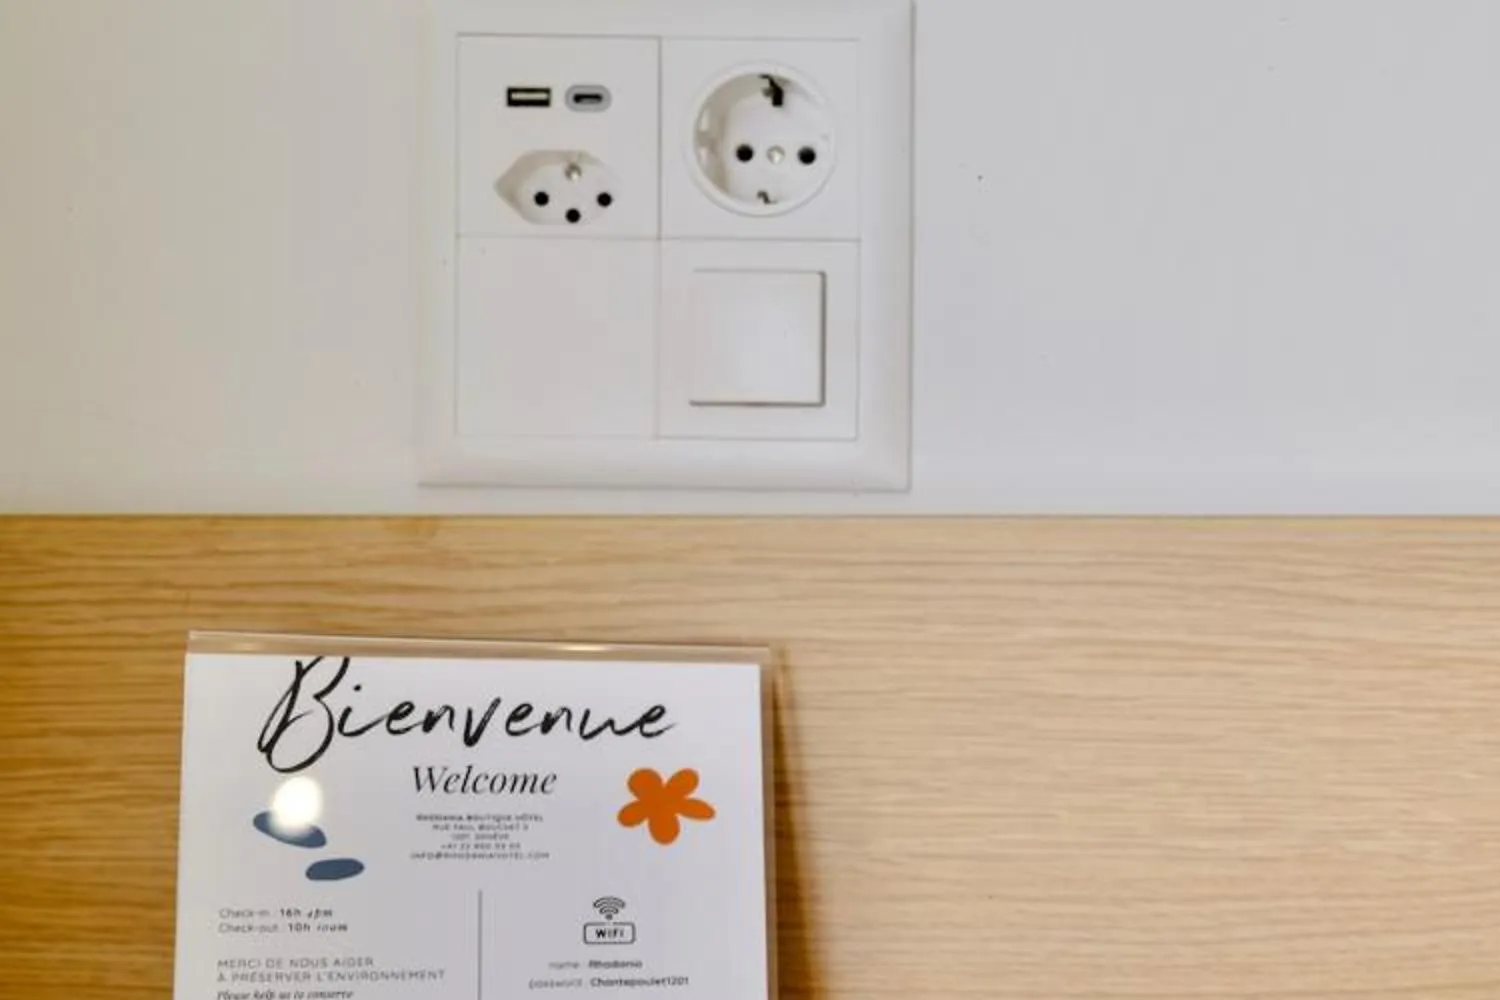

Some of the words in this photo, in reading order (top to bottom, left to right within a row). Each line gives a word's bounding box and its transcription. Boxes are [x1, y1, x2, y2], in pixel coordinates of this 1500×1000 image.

[257, 656, 678, 773] Bienvenue
[412, 765, 558, 795] Welcome
[217, 958, 262, 969] MERCI
[265, 958, 284, 969] DE
[290, 957, 328, 968] NOUS
[333, 956, 374, 967] AIDER
